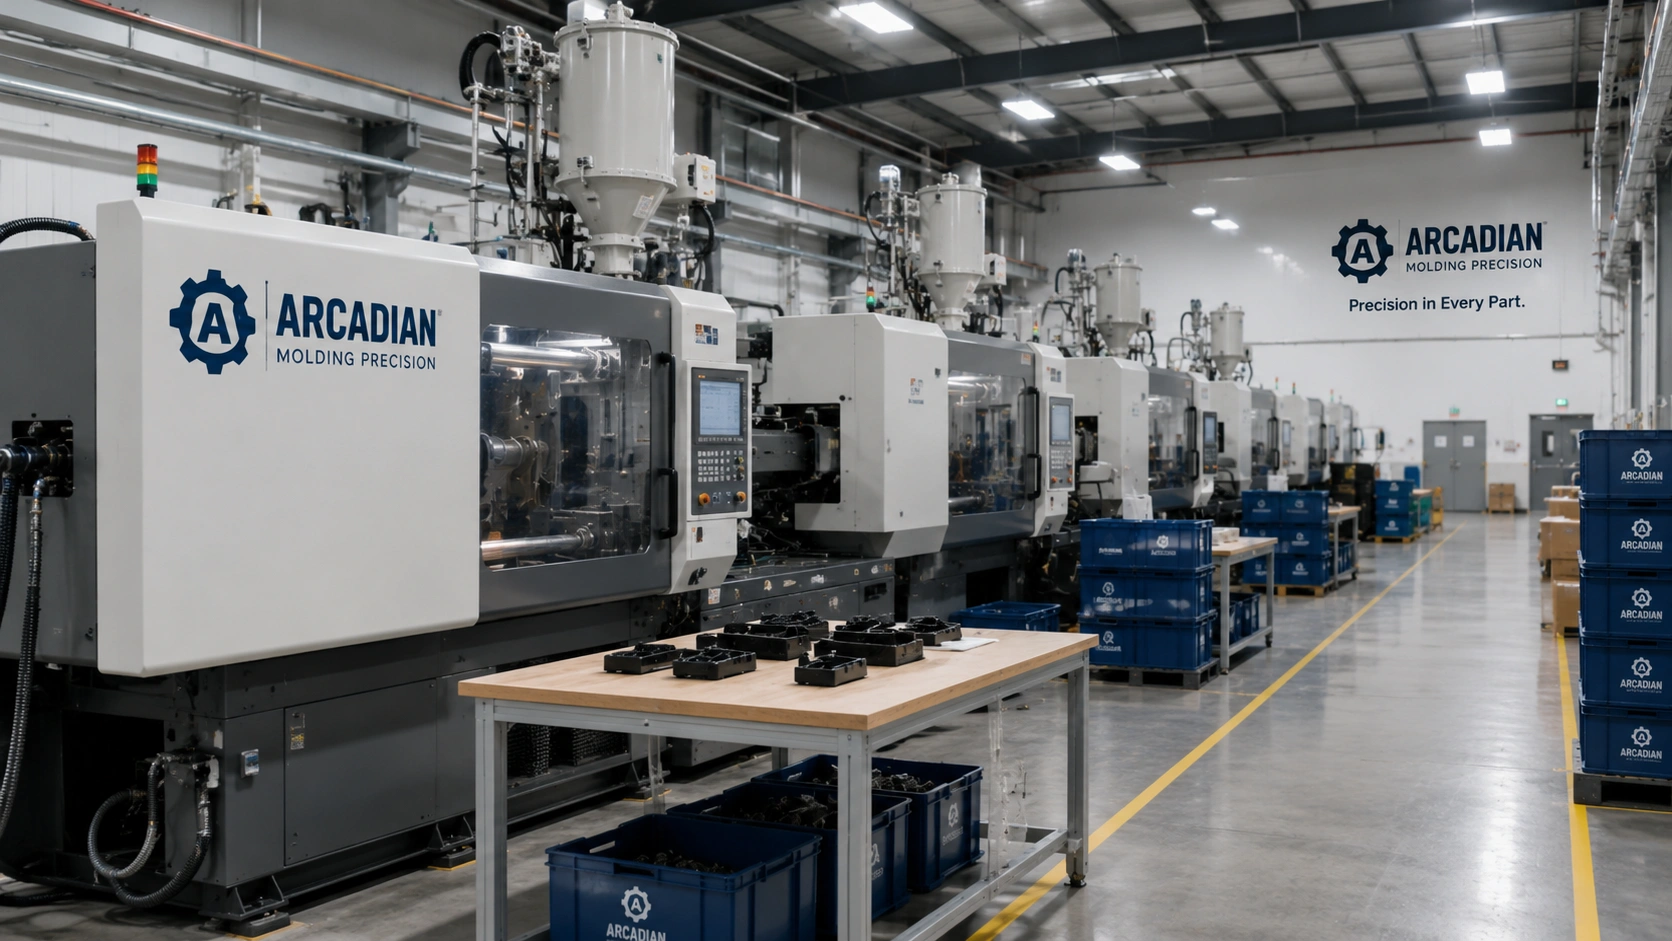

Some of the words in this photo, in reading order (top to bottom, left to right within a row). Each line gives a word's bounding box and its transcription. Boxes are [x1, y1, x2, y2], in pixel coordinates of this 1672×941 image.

[1405, 222, 1543, 256] ARCADIAN
[1406, 260, 1467, 273] MOLDING
[1471, 257, 1543, 271] PRECISION
[1349, 297, 1418, 312] Precision
[1422, 297, 1436, 310] in
[1441, 296, 1484, 313] Every
[1488, 294, 1526, 309] Part.
[276, 293, 436, 347] ARCADIAN
[276, 347, 355, 367] MOLDING
[361, 351, 436, 370] PRECISION
[1620, 471, 1663, 481] ARCADIAN
[1620, 540, 1663, 551] ARCADIAN
[1620, 609, 1663, 620] ARCADIAN
[1620, 679, 1663, 690] ARCADIAN
[1620, 748, 1663, 760] ARCADIAN
